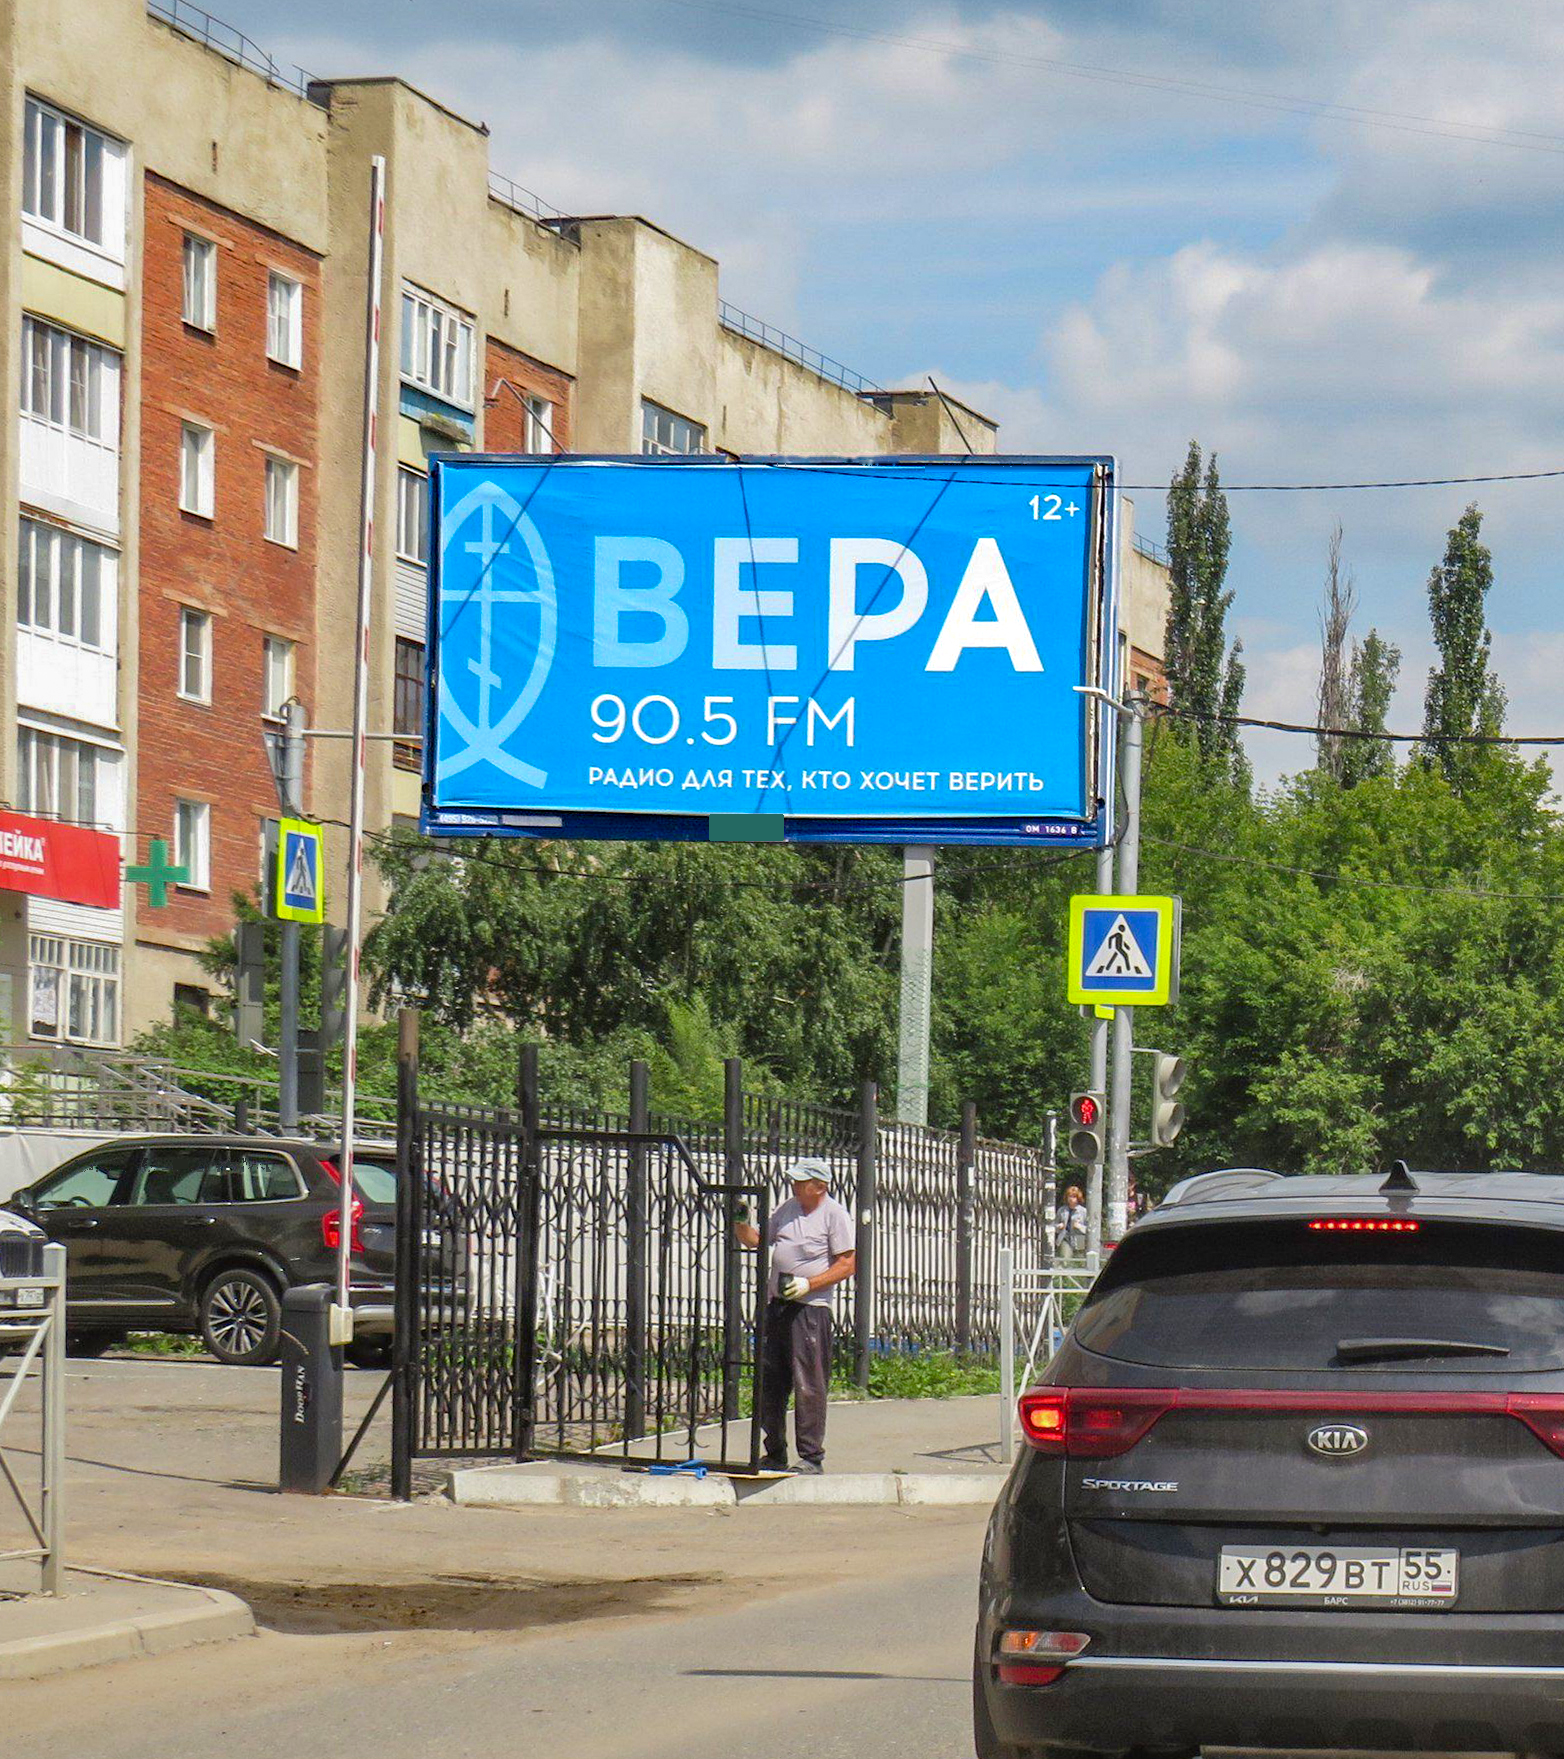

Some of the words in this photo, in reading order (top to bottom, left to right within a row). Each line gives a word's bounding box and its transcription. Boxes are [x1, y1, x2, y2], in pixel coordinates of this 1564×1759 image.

[1029, 494, 1080, 521] 12+
[593, 537, 1045, 673] ВЕРА
[590, 694, 738, 746] 90.5
[767, 696, 856, 747] FM
[589, 766, 674, 788] РАДИО
[682, 769, 733, 790] ДЛЯ
[742, 769, 792, 792] ТЕХ,
[802, 770, 851, 790] КТО
[860, 772, 939, 791] ХОЧЕТ
[948, 772, 1044, 791] ВЕРИТЬ
[0, 829, 44, 863] ЕЙКА
[1316, 1430, 1359, 1449] KIA
[1081, 1478, 1179, 1492] SPORTAGE
[1404, 1551, 1443, 1580] 55
[1402, 1581, 1430, 1592] RUS
[1323, 1596, 1349, 1606] БАРС
